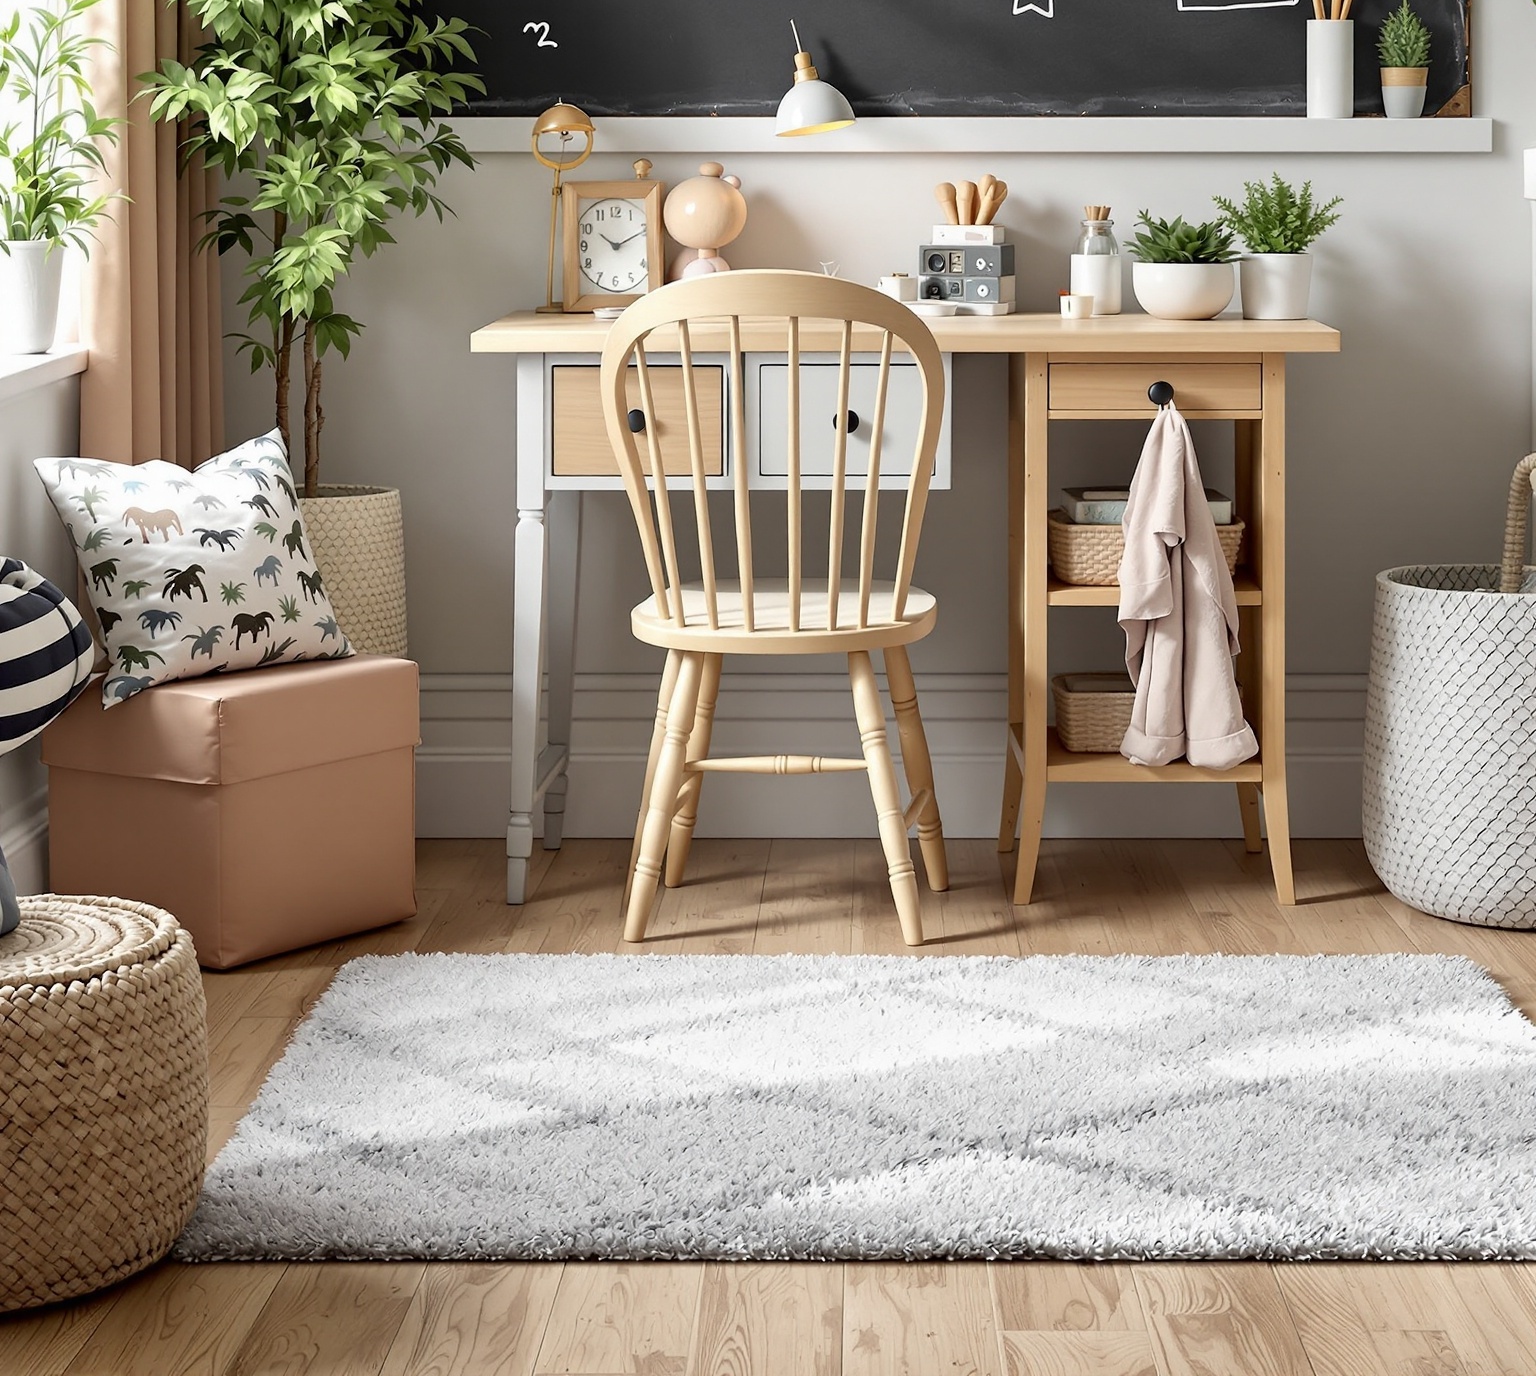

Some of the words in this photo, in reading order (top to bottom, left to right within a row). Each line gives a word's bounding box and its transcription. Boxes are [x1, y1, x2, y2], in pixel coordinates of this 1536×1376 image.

[596, 209, 605, 221] 11
[610, 207, 622, 218] 12
[629, 210, 632, 221] 1
[580, 223, 593, 234] 10
[580, 240, 588, 253] 9
[584, 258, 592, 269] 8
[596, 272, 603, 285] 7
[612, 276, 619, 287] 6
